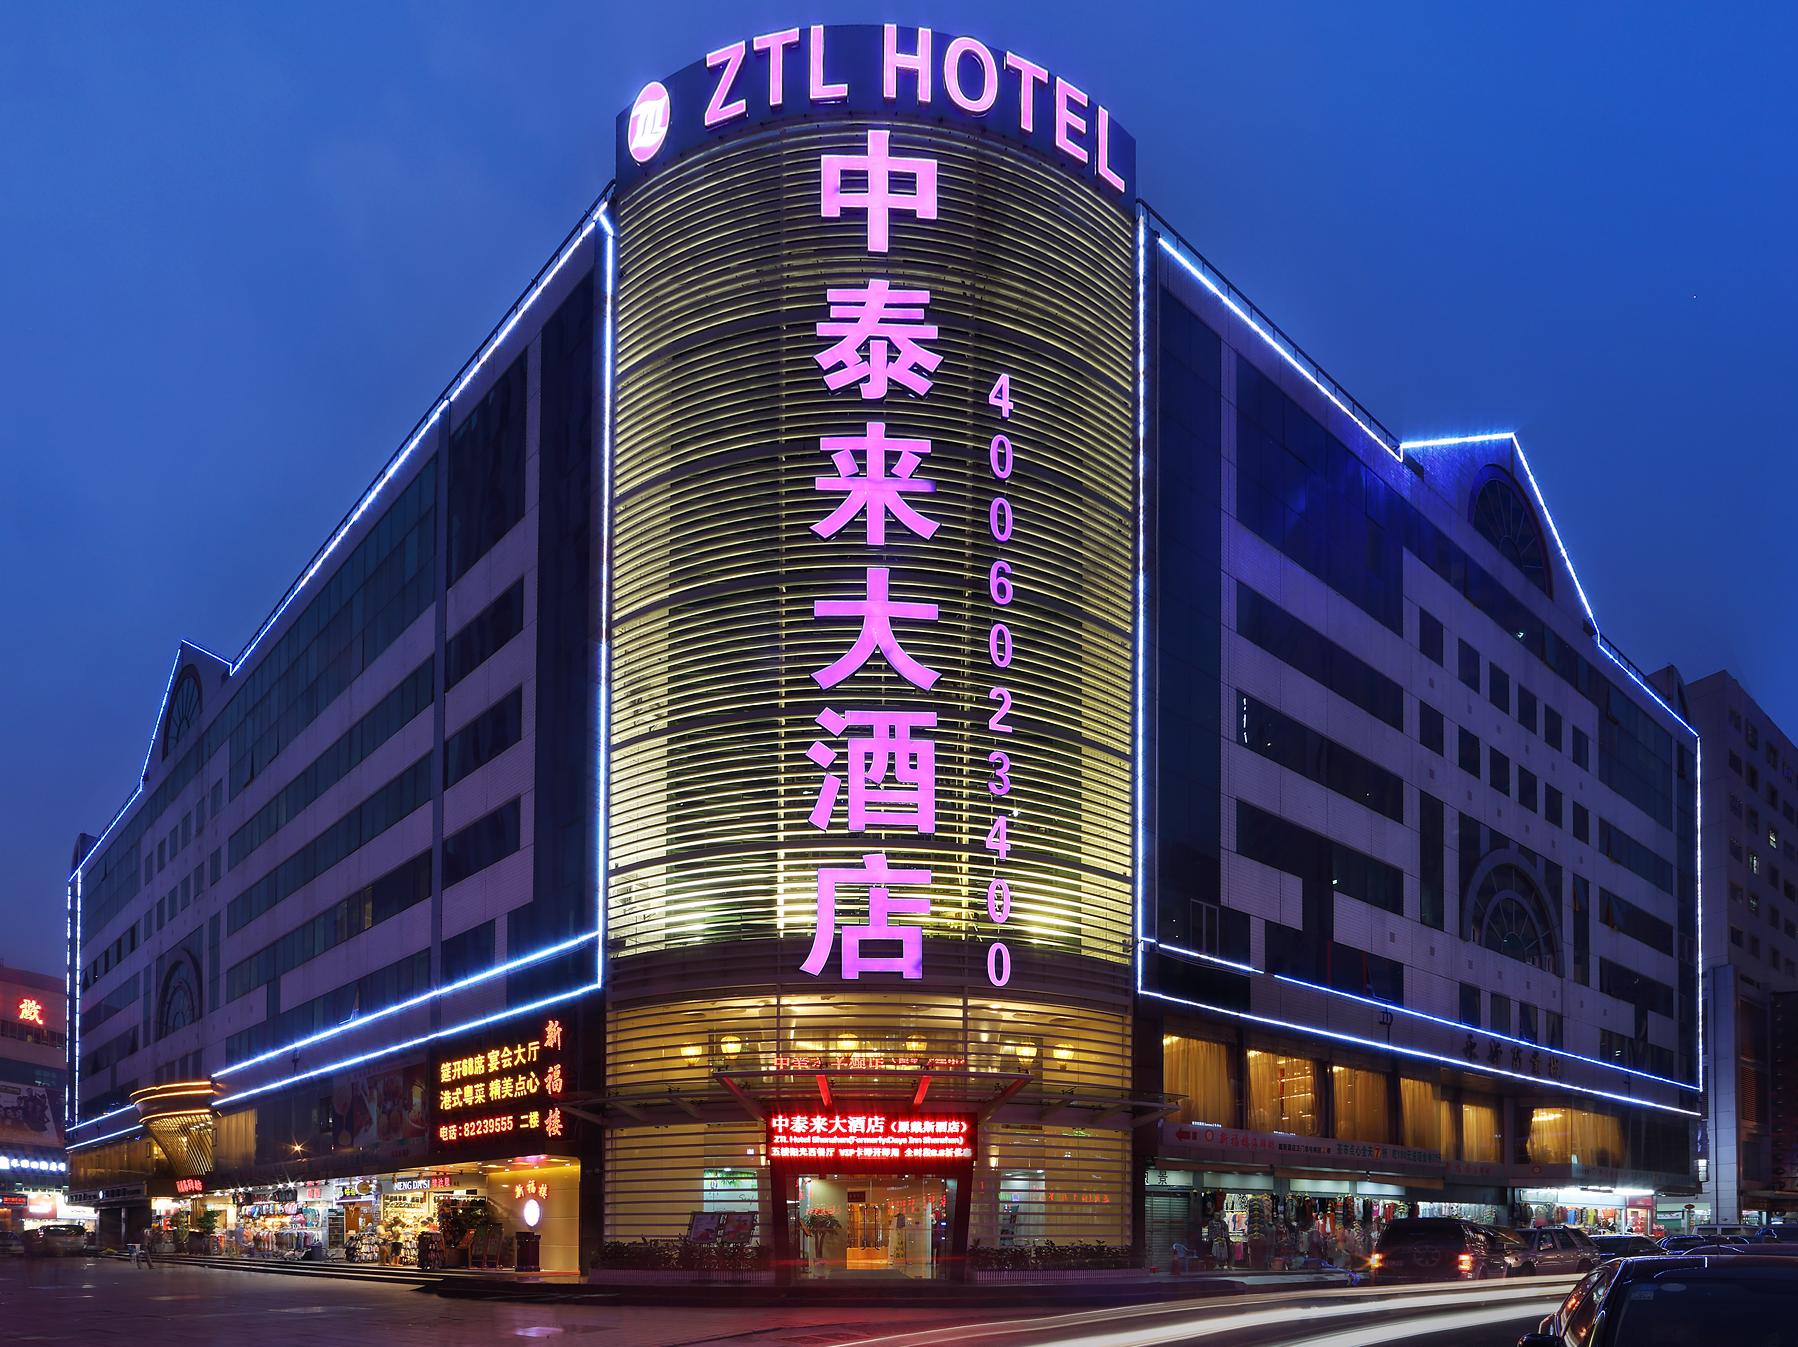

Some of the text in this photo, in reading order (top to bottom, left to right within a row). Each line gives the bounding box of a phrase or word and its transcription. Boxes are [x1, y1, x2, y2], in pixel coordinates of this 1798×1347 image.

[704, 23, 1126, 193] ZTL HOTEL
[800, 130, 943, 981] 中泰来大酒店
[986, 373, 1014, 987] 4006023400
[487, 1041, 540, 1072] 宴会大厅
[440, 1072, 540, 1110] 港式粤菜 精美点心
[519, 1111, 540, 1129] 二楼
[772, 1115, 885, 1133] 中泰来大酒店
